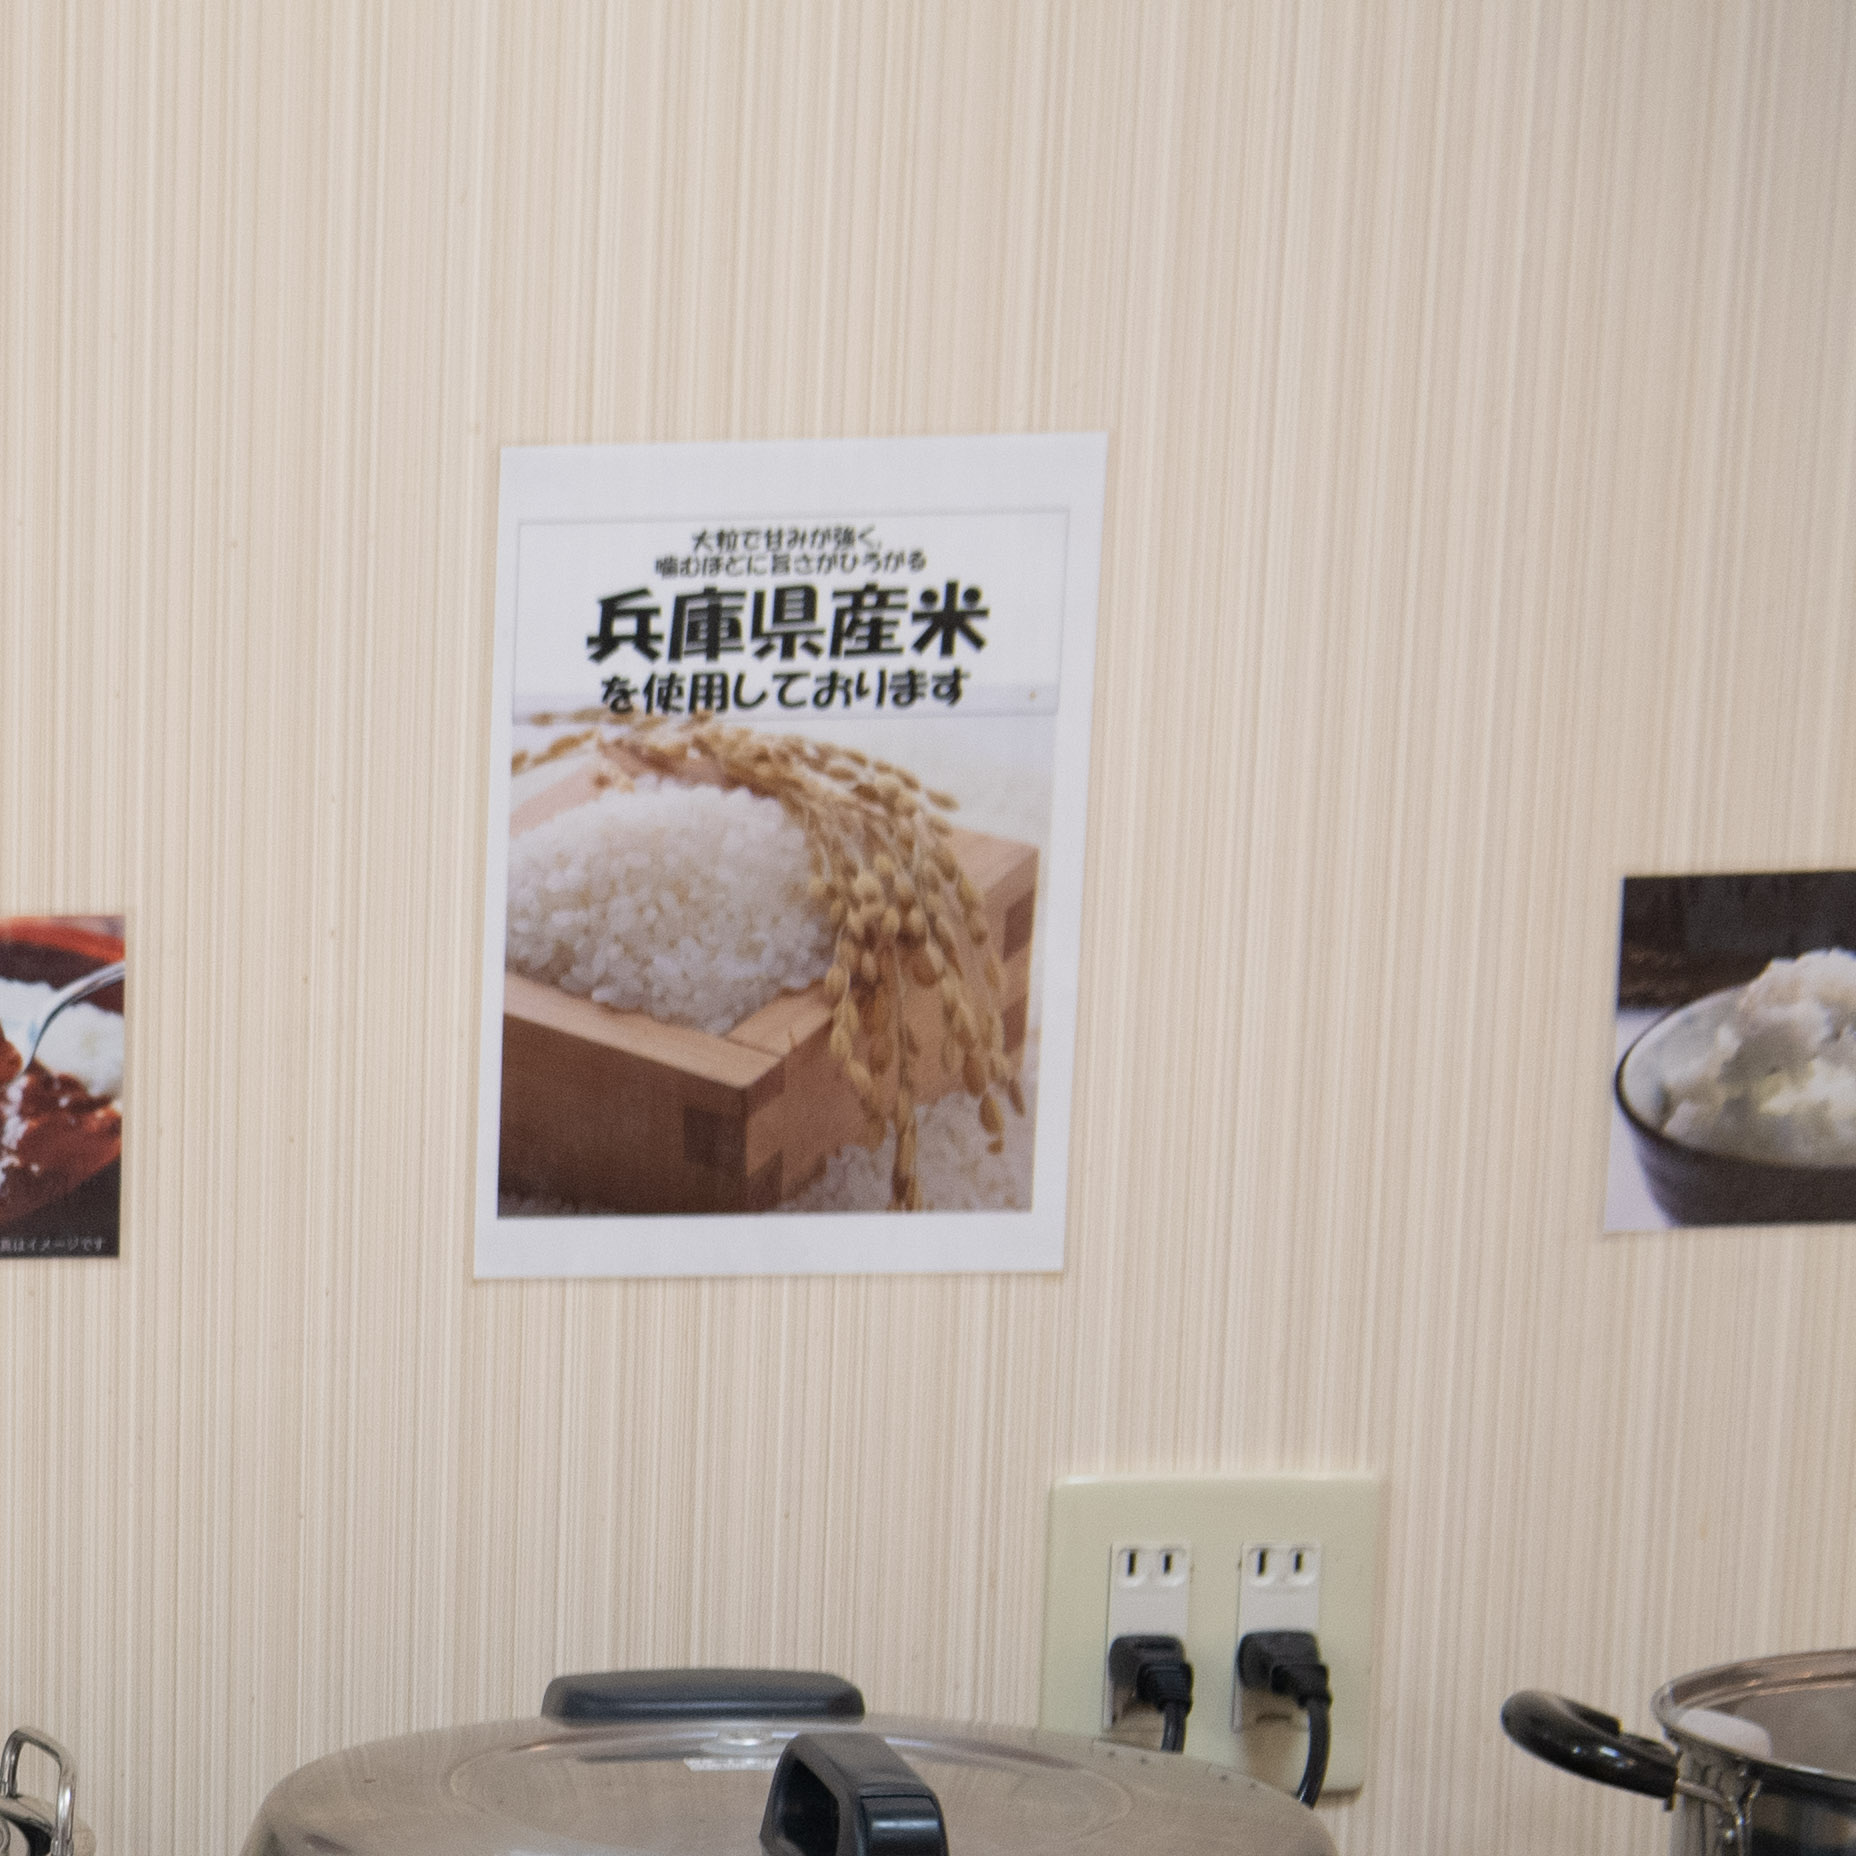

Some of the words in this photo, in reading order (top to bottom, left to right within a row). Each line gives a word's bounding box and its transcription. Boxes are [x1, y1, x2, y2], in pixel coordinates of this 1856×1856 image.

[585, 580, 991, 665] 兵庫県産米
[600, 667, 971, 716] を使用しております
